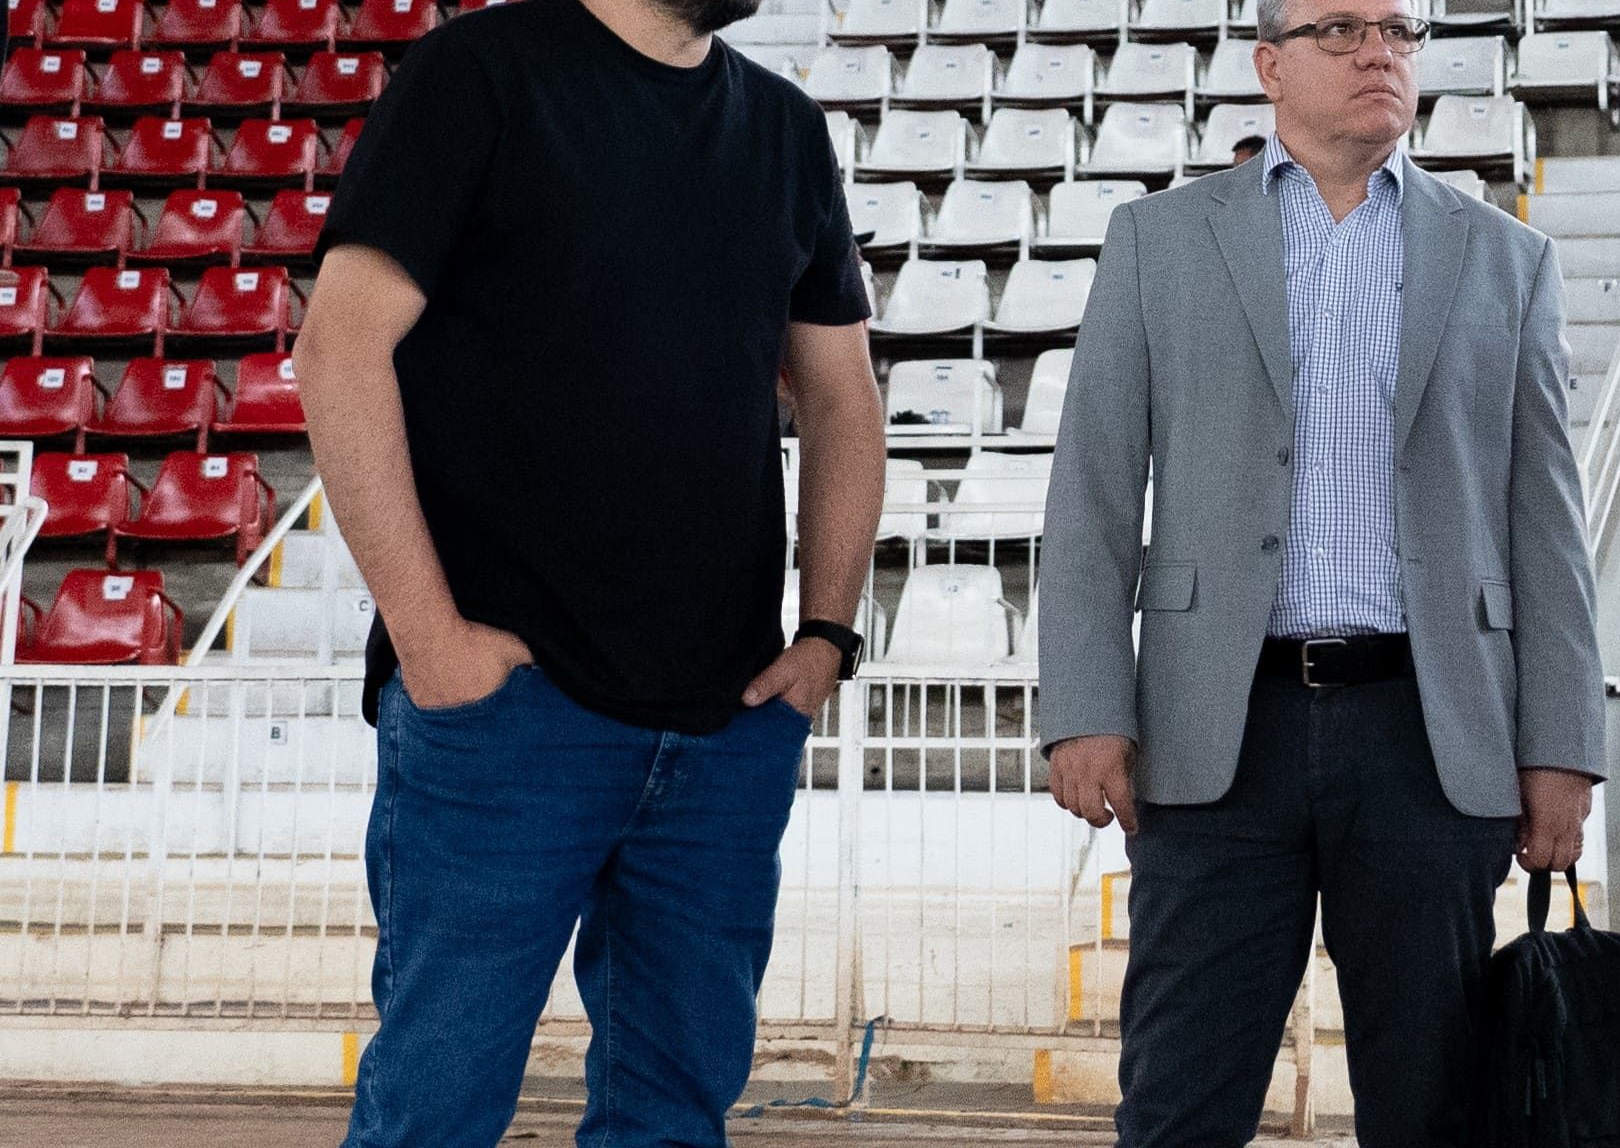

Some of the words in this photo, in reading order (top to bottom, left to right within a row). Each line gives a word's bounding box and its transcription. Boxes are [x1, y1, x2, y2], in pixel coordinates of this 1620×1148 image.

[1569, 378, 1578, 390] E
[358, 599, 369, 612] C
[270, 726, 282, 740] B
